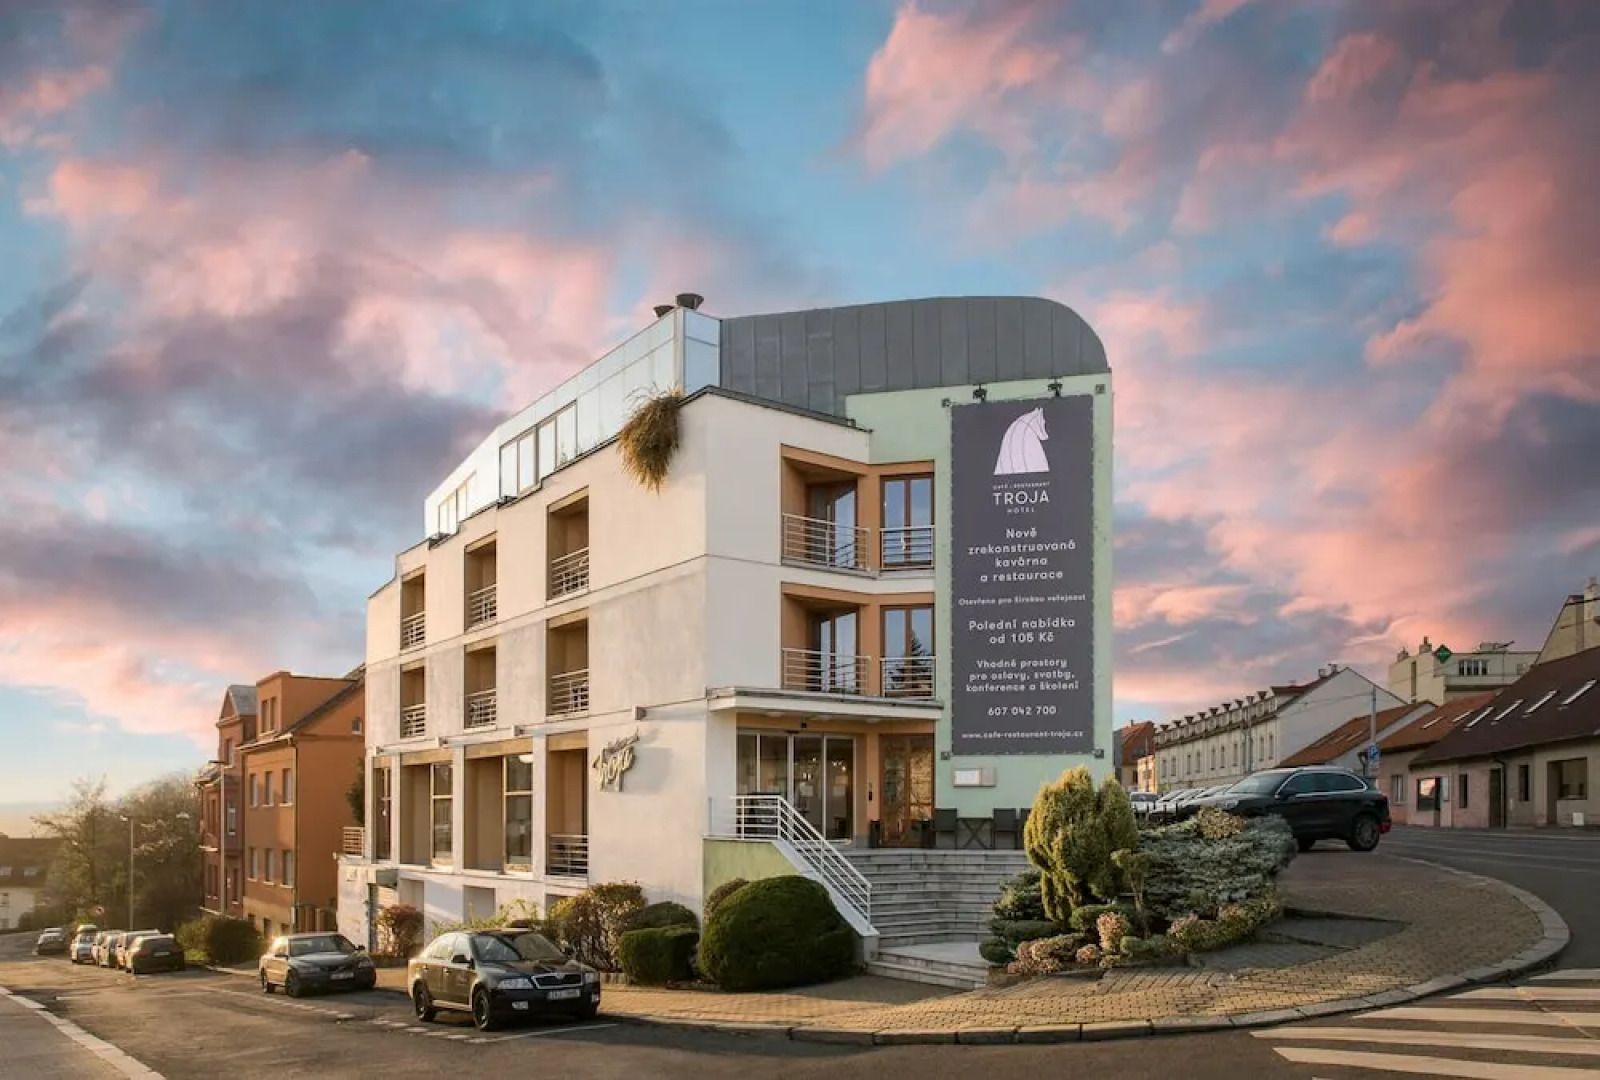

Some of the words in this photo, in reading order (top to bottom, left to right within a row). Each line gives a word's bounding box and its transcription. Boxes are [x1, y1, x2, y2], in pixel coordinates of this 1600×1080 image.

[992, 490, 1050, 505] TROJA
[1005, 527, 1038, 539] Nově
[968, 539, 1076, 556] zrekonstruovaná
[994, 557, 1048, 568] kavárna
[980, 574, 988, 582] a
[992, 571, 1064, 582] restaurace
[968, 619, 1017, 631] Polední
[1021, 617, 1076, 629] nabídka
[989, 633, 1006, 644] od
[1038, 631, 1054, 643] Kč
[1020, 658, 1069, 670] prostory
[1034, 669, 1076, 680] svatby,
[965, 683, 1026, 692] konference
[987, 706, 1009, 716] 607
[1010, 706, 1033, 716] 042
[1036, 705, 1057, 715] 700
